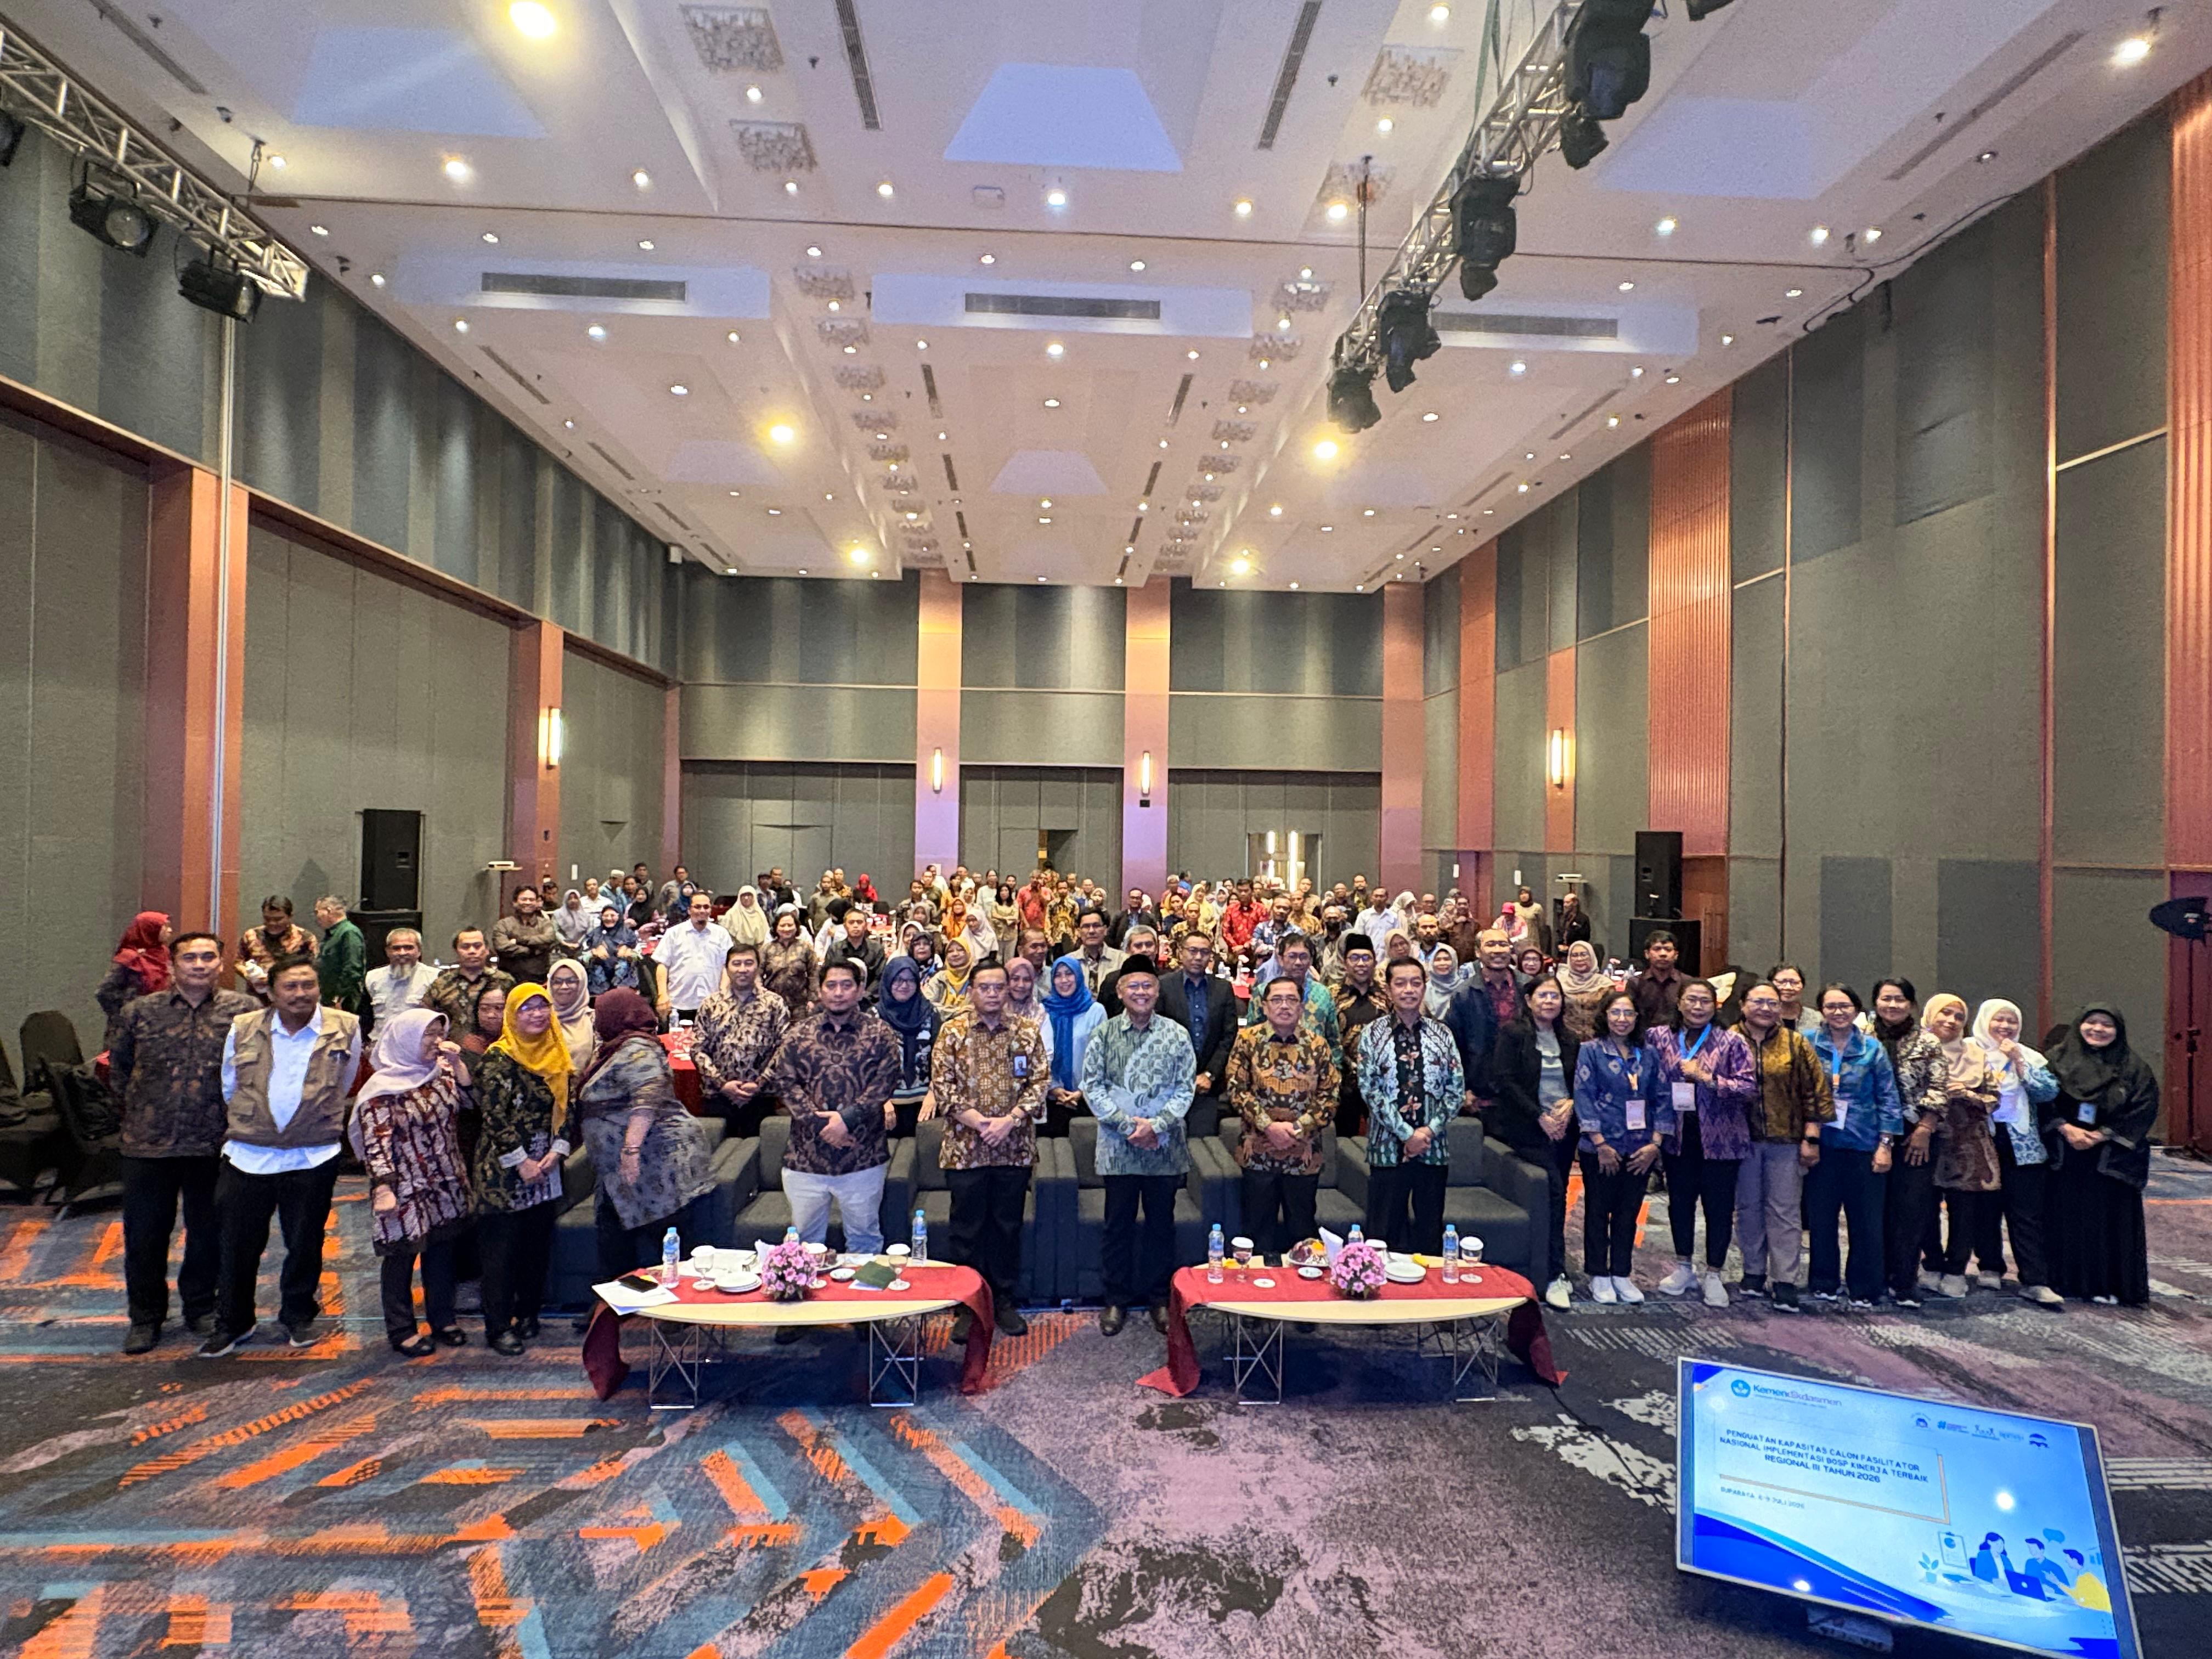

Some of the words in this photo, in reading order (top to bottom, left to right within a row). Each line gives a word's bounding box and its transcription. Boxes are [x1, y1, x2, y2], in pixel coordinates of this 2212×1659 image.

[1720, 1437, 1761, 1451] NASIONAL
[1763, 1444, 1824, 1463] IMPLEMENTASI
[1826, 1457, 1848, 1467] BOSP
[1851, 1462, 1888, 1475] KINERJA
[1892, 1469, 1929, 1482] TERBAIK
[1726, 1429, 1776, 1444] PENGUATAN
[1778, 1439, 1827, 1454] KAPASITAS
[1830, 1448, 1859, 1460] CALON
[1861, 1454, 1920, 1471] FASILITATOR
[1764, 1454, 1810, 1470] REGIONAL
[1823, 1465, 1855, 1478] TAHUN
